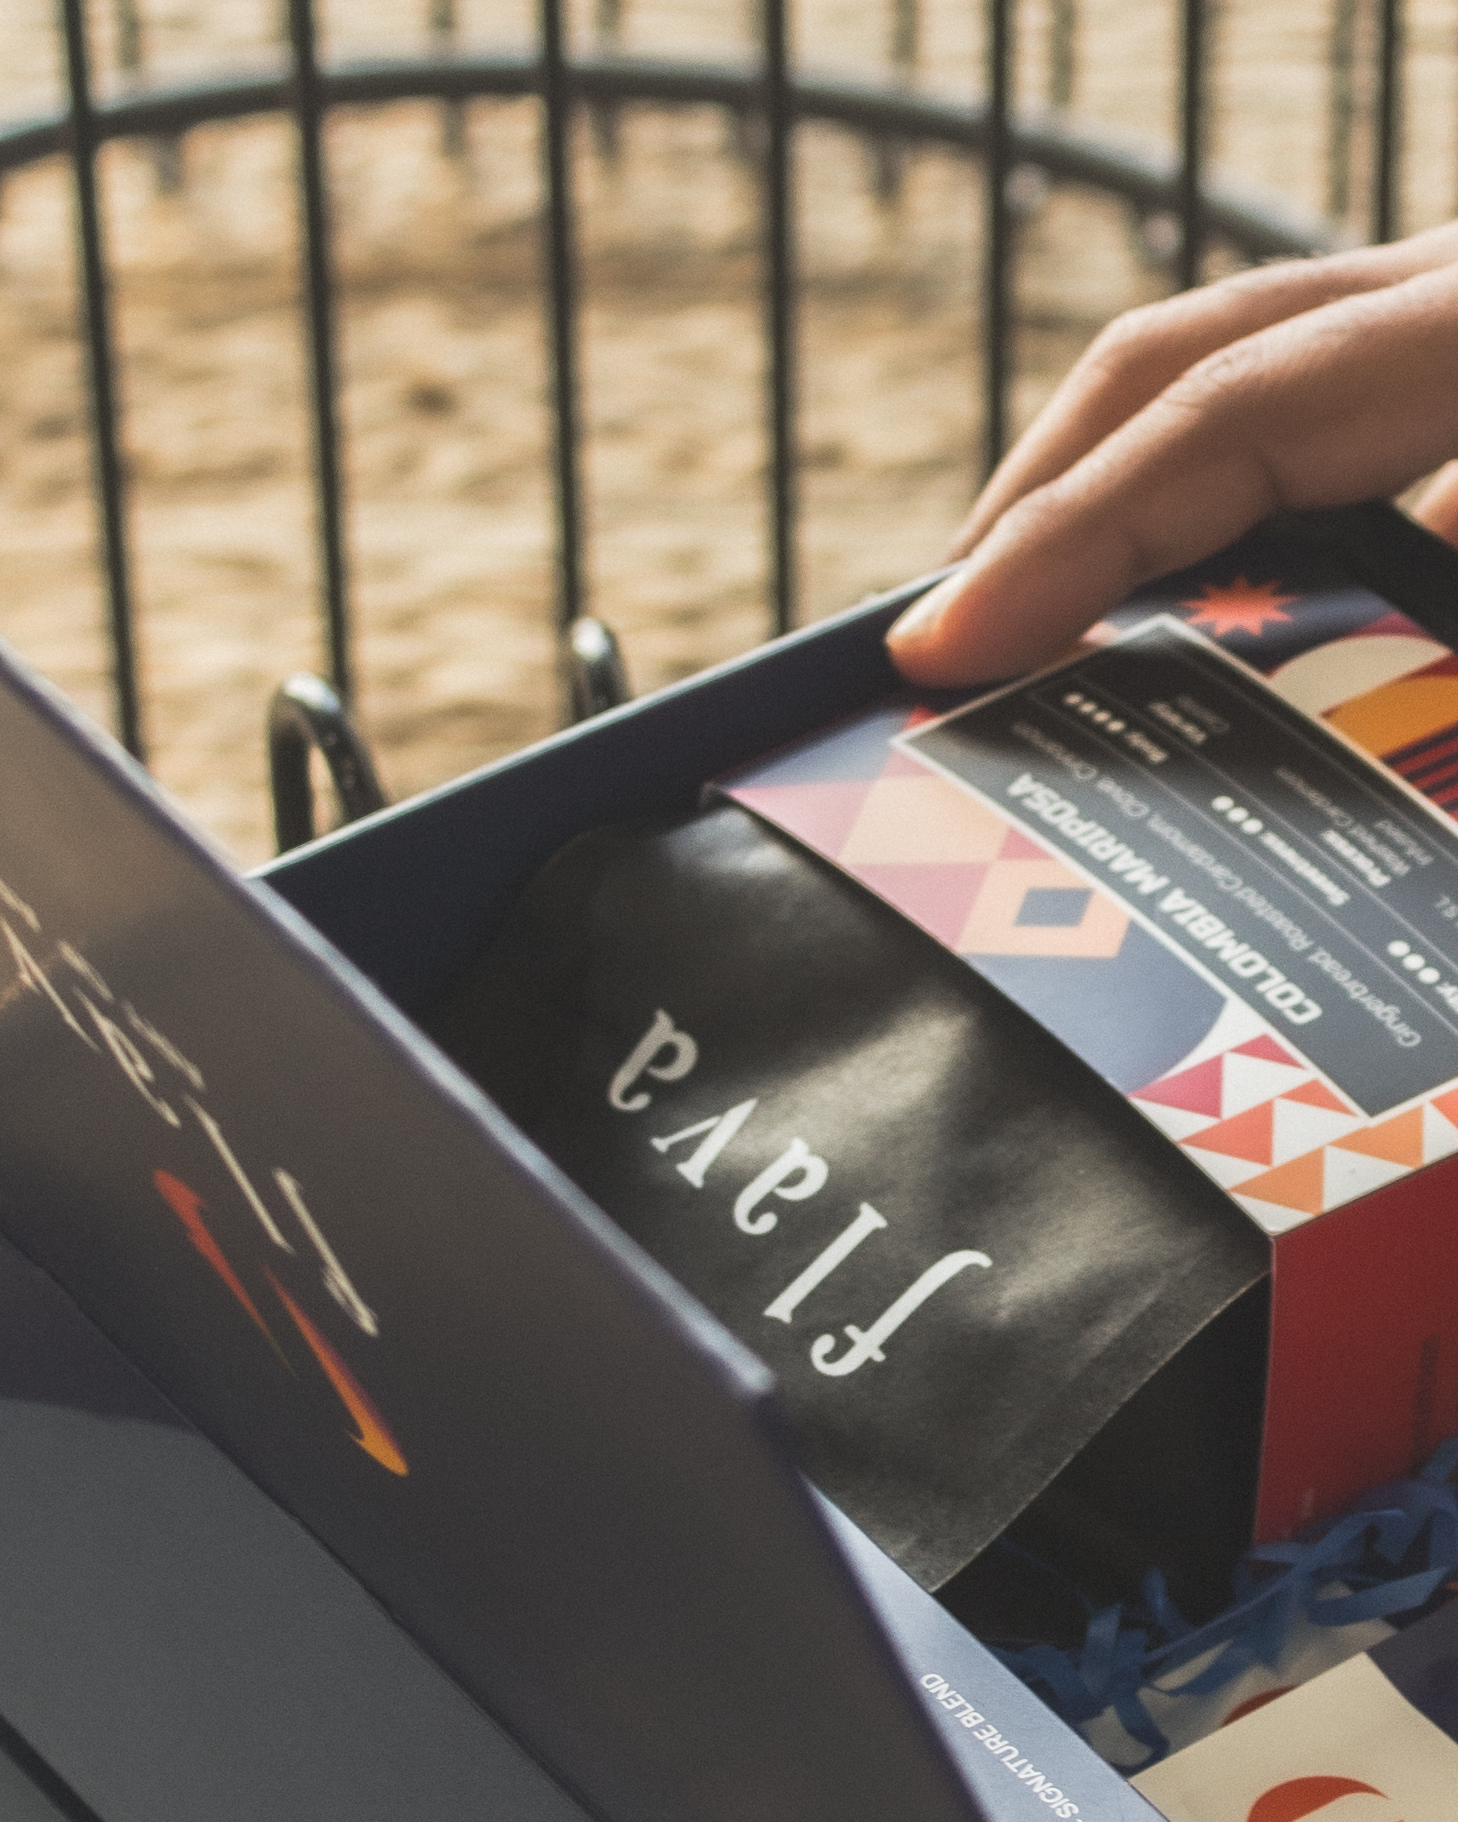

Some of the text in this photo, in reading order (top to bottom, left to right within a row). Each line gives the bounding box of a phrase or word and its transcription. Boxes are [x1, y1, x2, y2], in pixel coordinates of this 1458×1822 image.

[1003, 771, 1326, 1026] COLOMBIA MARIPOSA
[1230, 883, 1315, 950] Roasted
[608, 1008, 993, 1378] flava
[919, 1673, 985, 1730] BLEND
[973, 1723, 1079, 1819] SIGNATURE
